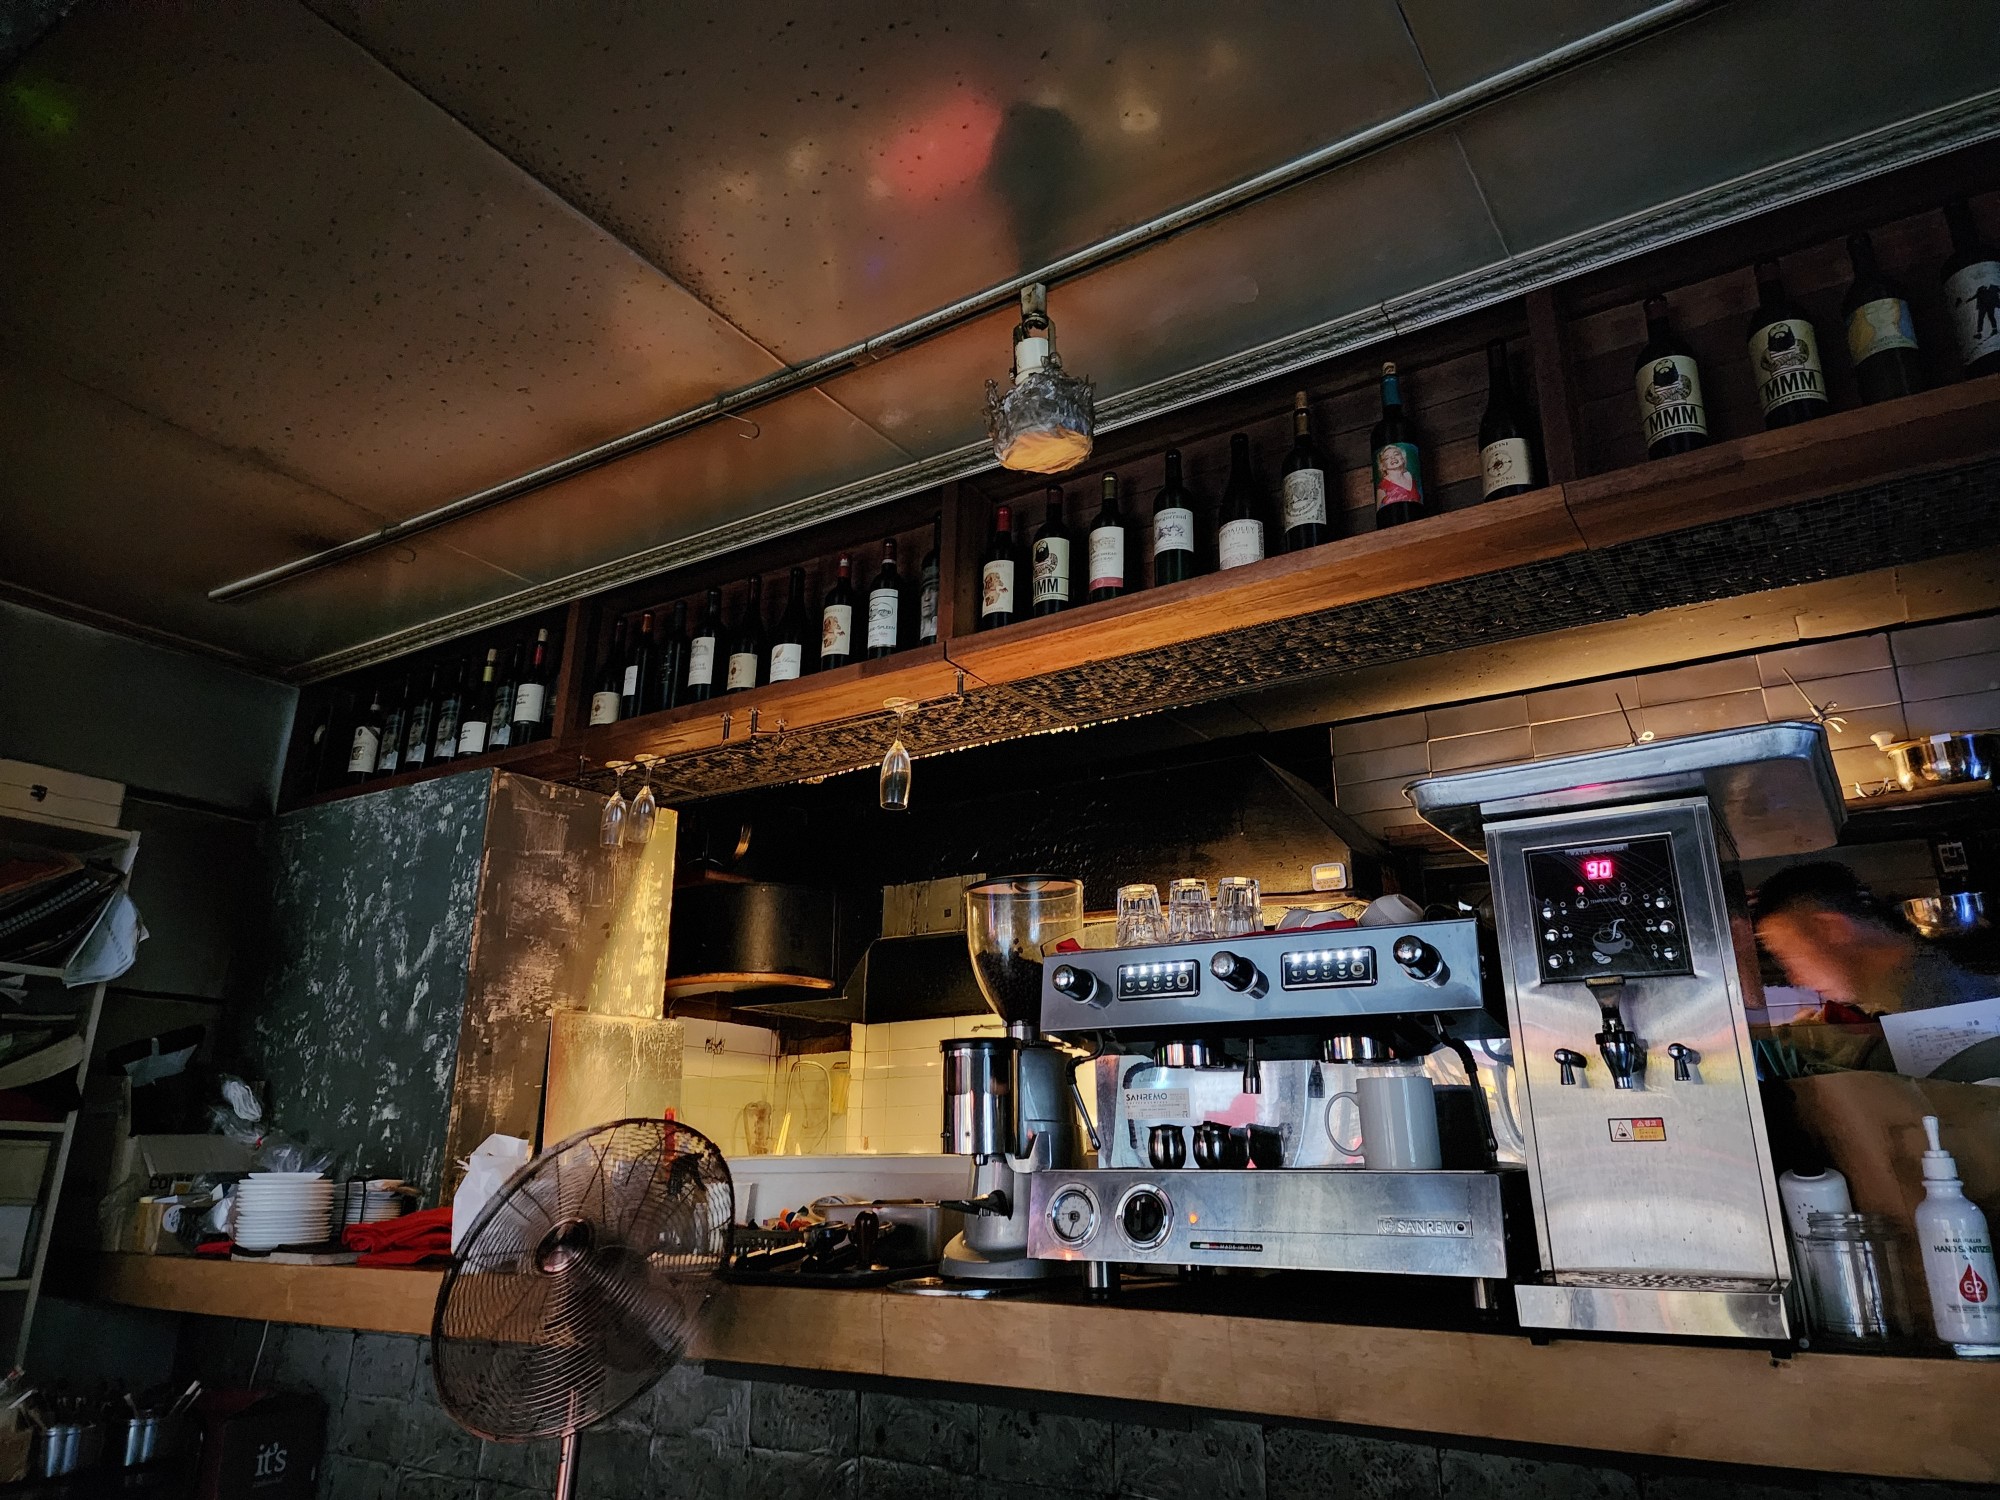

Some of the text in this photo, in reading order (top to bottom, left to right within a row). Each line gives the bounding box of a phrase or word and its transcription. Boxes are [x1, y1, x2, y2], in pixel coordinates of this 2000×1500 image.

[1765, 371, 1817, 402] MMM
[1649, 405, 1698, 435] MMM
[1587, 862, 1611, 878] 90
[1126, 1093, 1168, 1101] SANREMO
[1397, 1221, 1467, 1235] SANREMO
[1963, 1280, 1984, 1294] 62
[254, 1441, 288, 1477] it's
